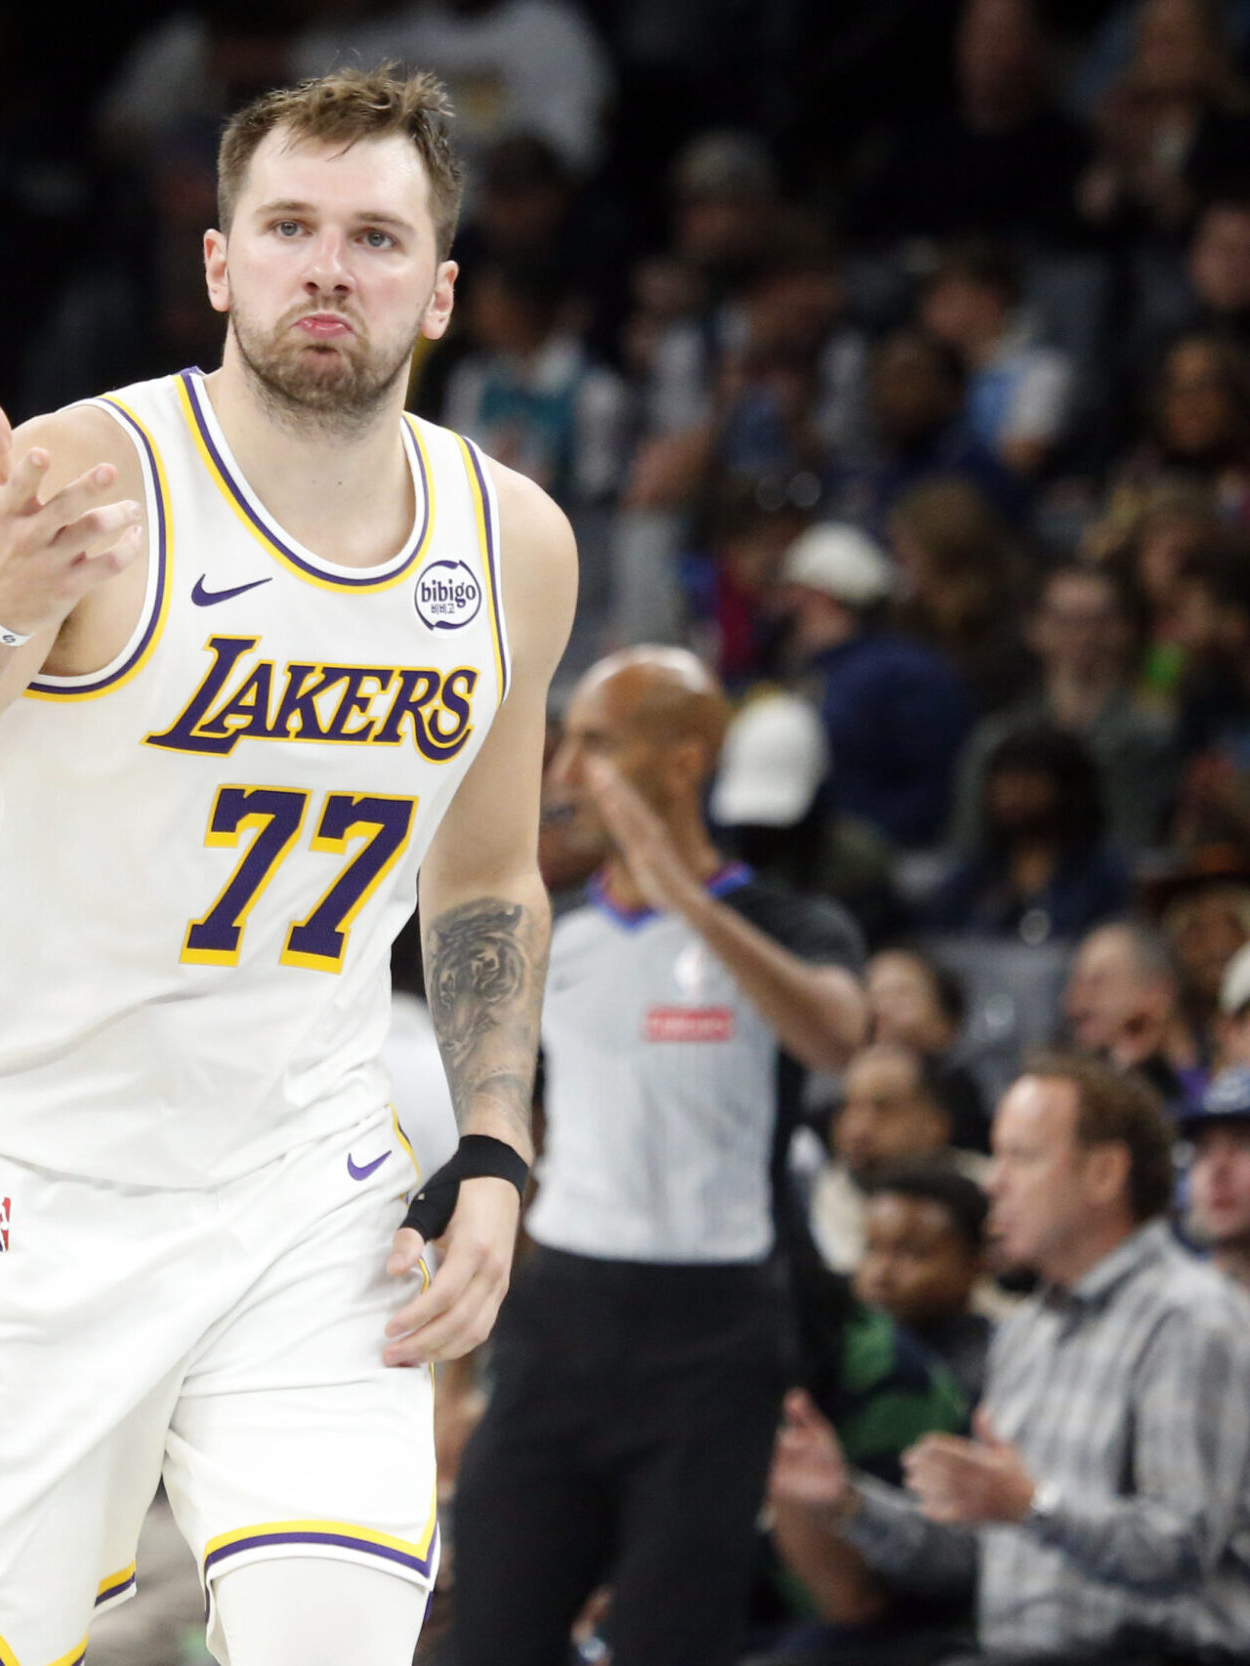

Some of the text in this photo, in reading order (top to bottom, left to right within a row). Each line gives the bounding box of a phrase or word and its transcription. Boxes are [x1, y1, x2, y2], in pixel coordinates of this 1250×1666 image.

[421, 579, 477, 609] bibigo
[141, 635, 481, 765] LAKERS
[179, 783, 419, 975] 77
